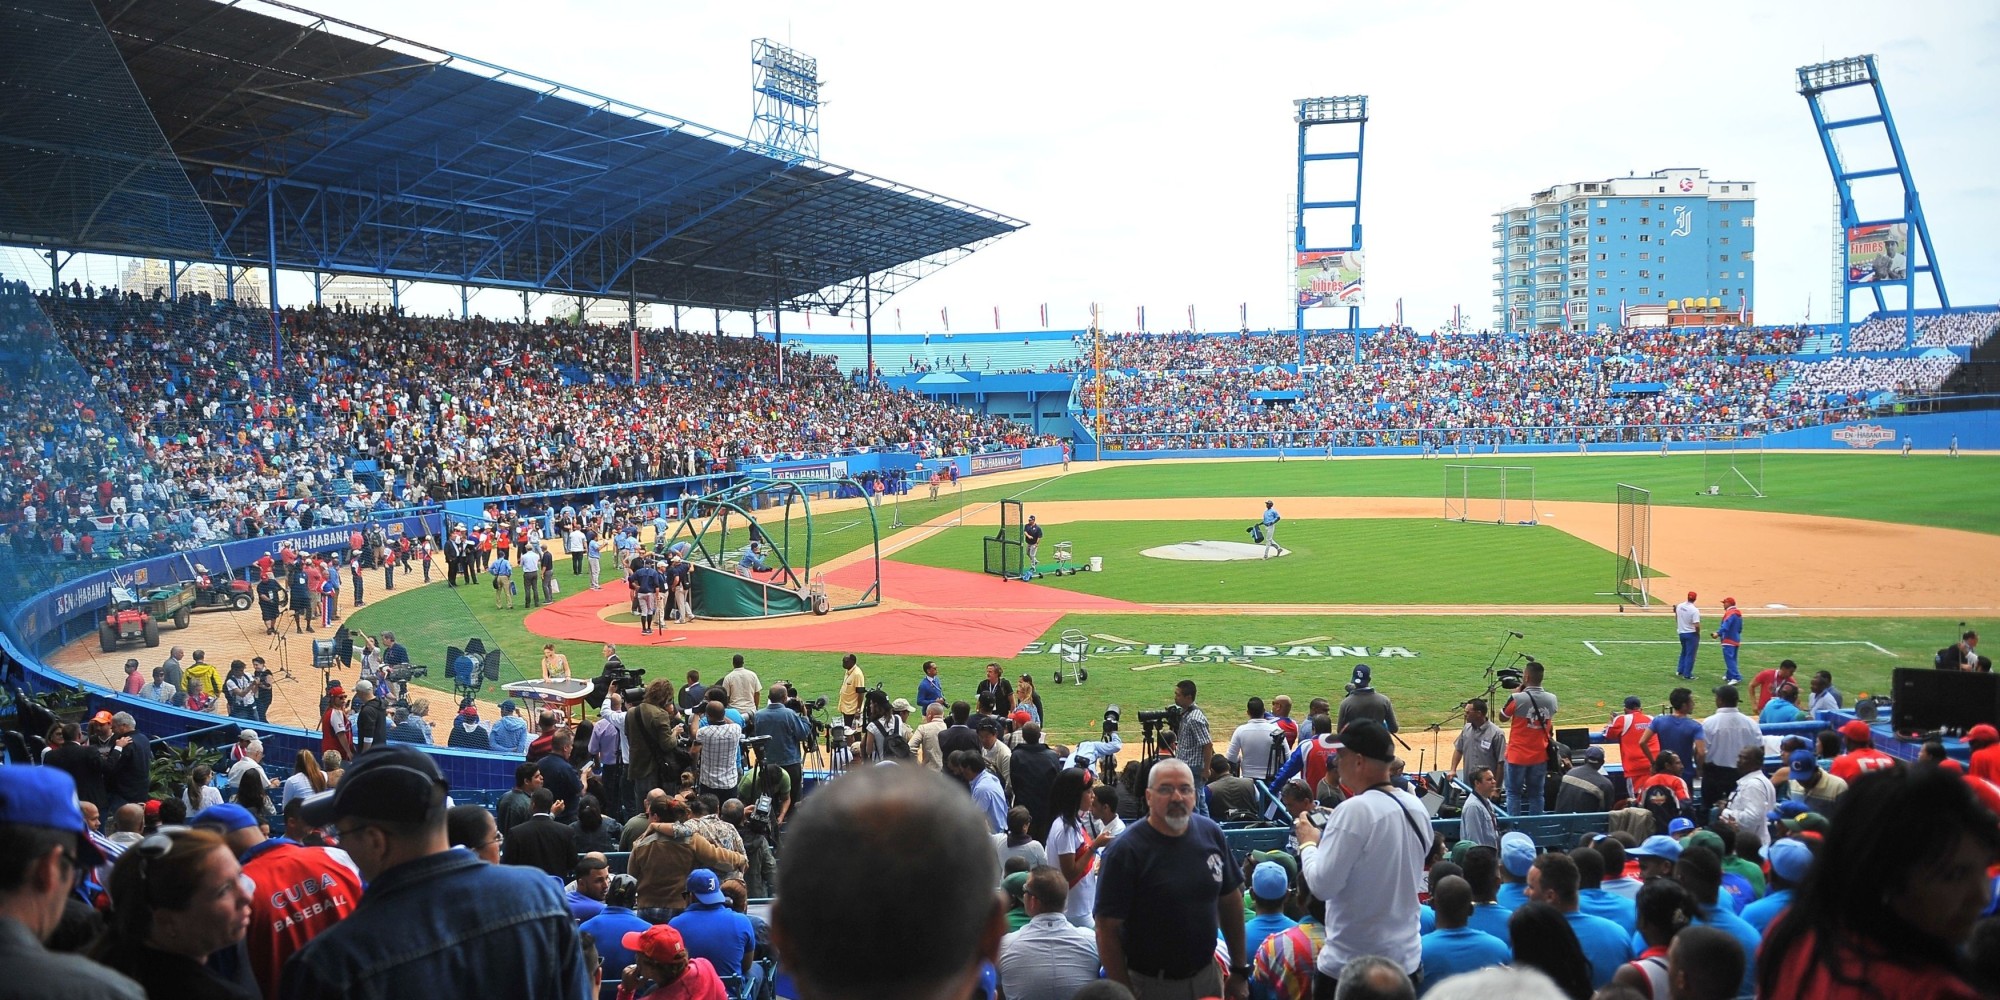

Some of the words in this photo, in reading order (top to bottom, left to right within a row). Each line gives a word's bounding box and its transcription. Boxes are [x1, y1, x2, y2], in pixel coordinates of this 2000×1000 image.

[1850, 242, 1883, 254] Firmes
[1312, 280, 1343, 291] Libres
[784, 471, 795, 479] EN
[800, 468, 829, 479] HABANA
[309, 530, 349, 549] HABANA
[64, 592, 74, 613] EN
[77, 582, 106, 608] HABANA
[1017, 642, 1089, 655] EN
[1093, 646, 1134, 654] LA
[1143, 644, 1420, 657] HABANA
[271, 873, 337, 909] CUBA
[273, 894, 347, 932] BASEBALL
